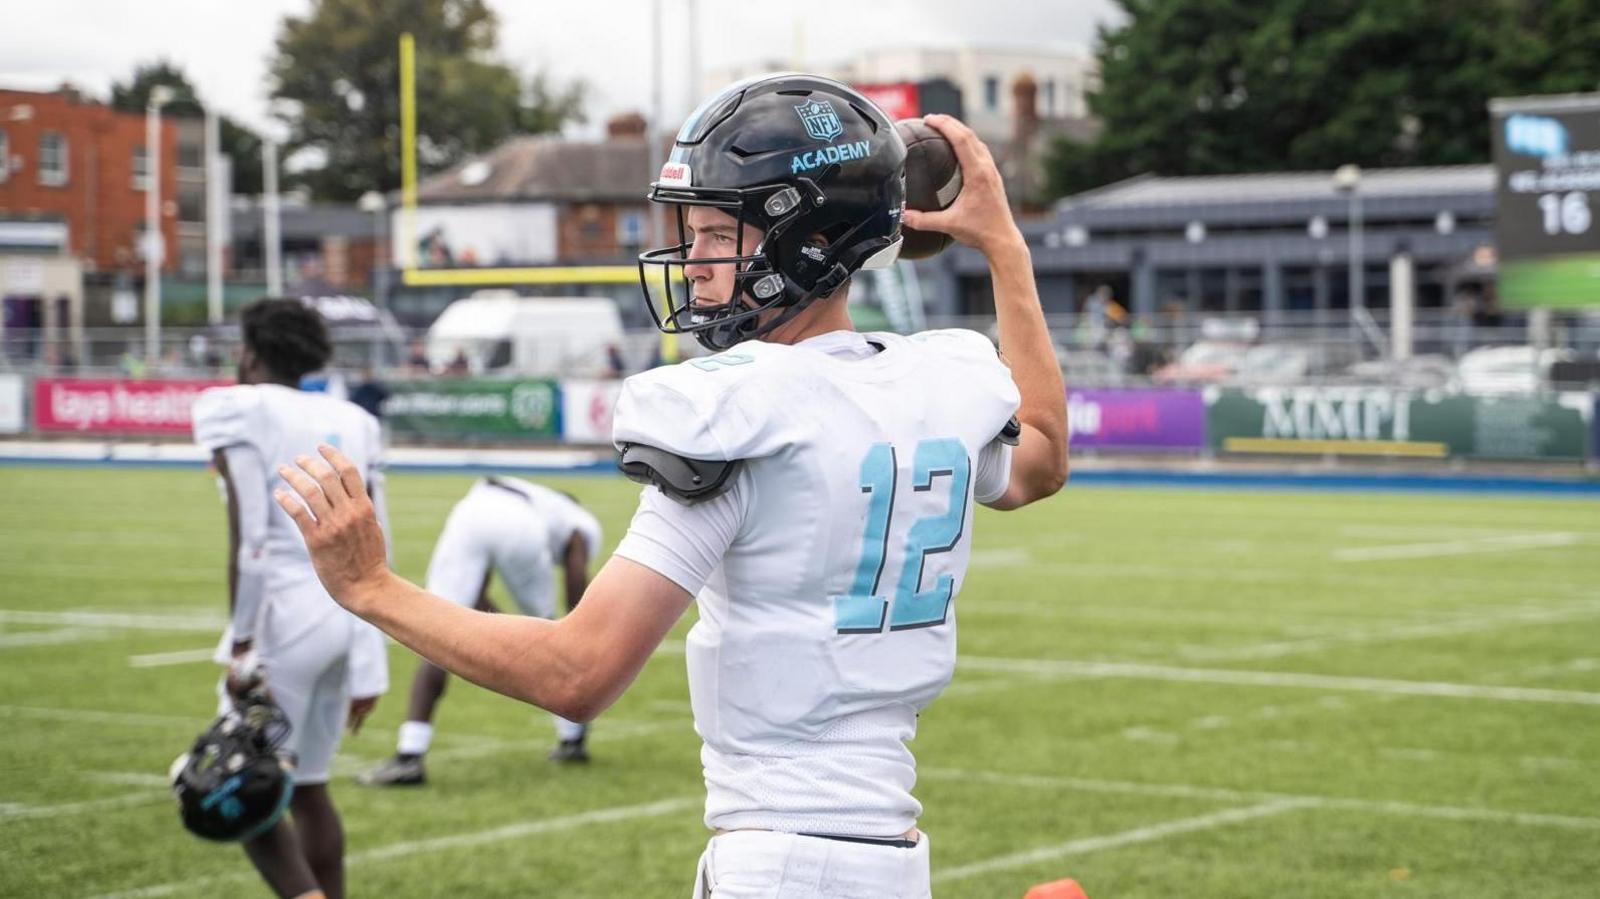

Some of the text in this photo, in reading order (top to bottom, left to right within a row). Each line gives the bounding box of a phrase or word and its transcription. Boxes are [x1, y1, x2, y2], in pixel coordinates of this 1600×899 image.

[806, 115, 840, 135] NFL
[791, 140, 871, 174] ACADEMY
[1538, 191, 1592, 236] 16
[1260, 387, 1412, 440] MMPI
[834, 436, 972, 635] 12
